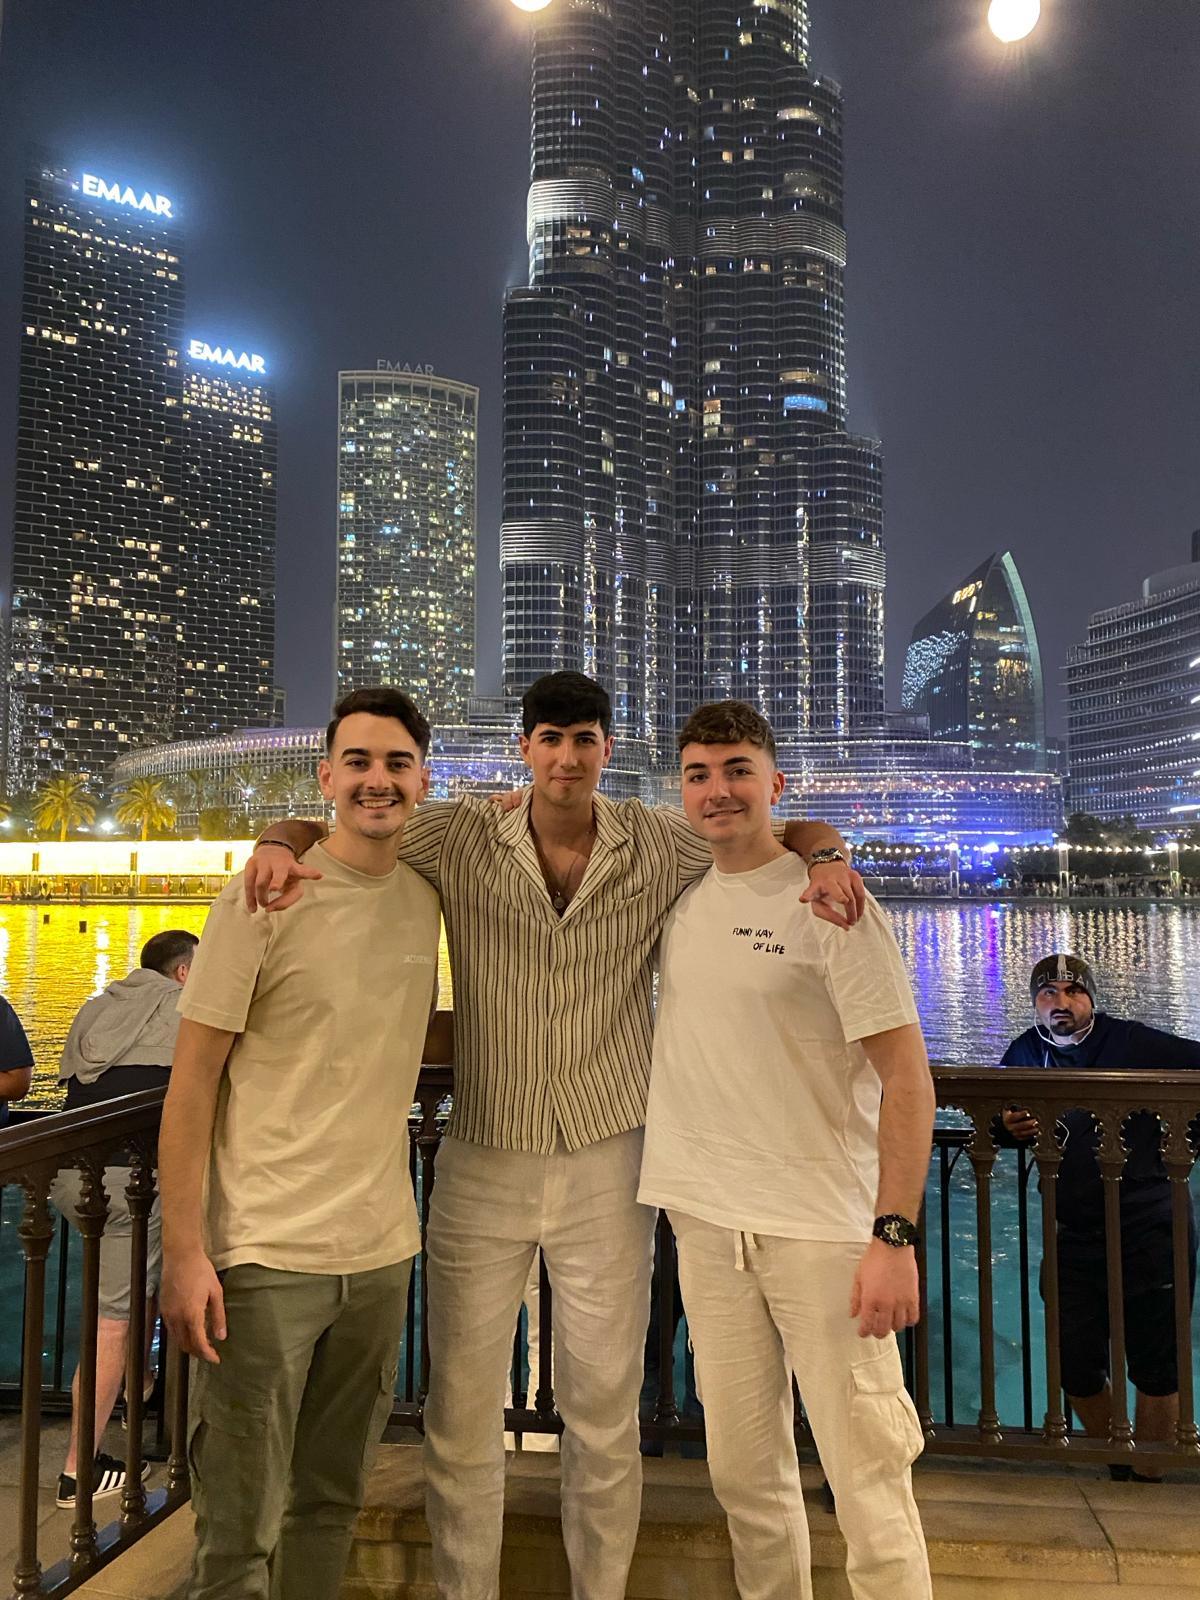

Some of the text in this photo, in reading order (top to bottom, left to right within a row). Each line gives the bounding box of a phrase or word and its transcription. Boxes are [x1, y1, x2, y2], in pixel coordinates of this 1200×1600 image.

[83, 173, 173, 218] EMAAR
[190, 339, 266, 374] EMAAR
[376, 359, 434, 376] EMAAR
[732, 927, 774, 938] FUNNY WAY
[753, 942, 785, 955] OF LIFE
